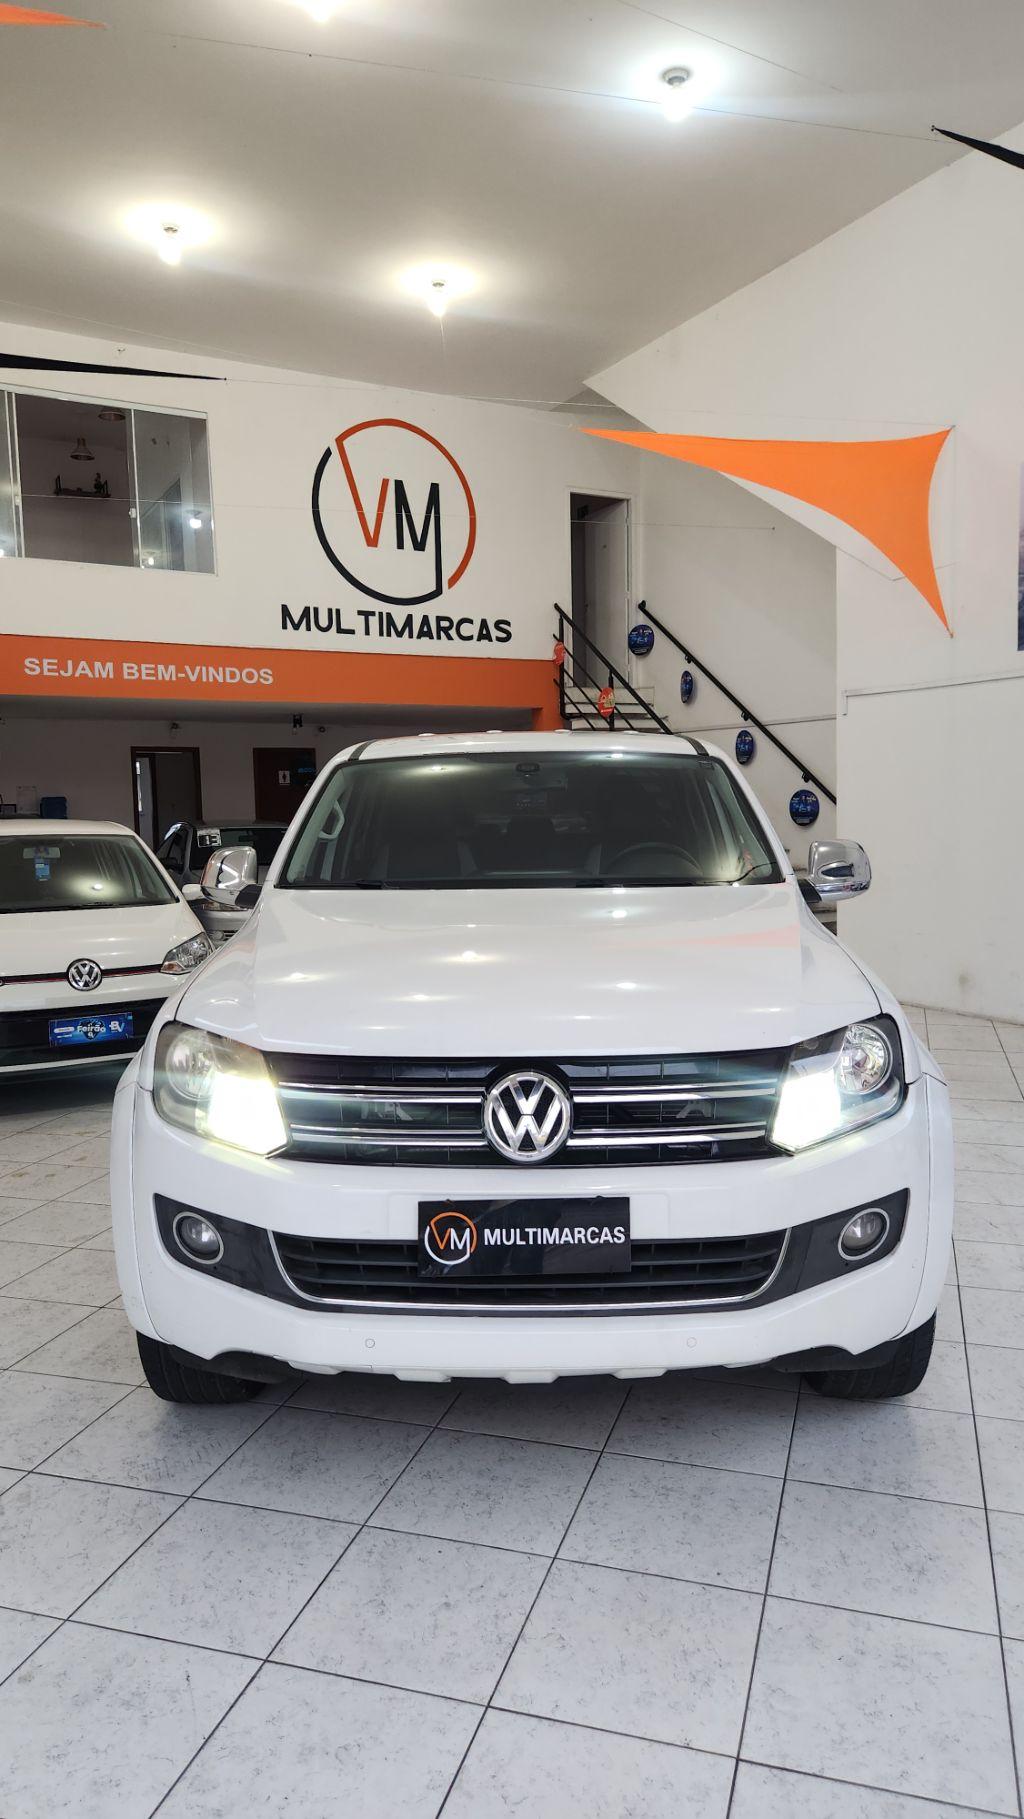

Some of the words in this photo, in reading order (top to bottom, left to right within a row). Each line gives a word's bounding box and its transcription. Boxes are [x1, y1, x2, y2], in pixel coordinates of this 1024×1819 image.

[281, 604, 513, 642] MULTIMARCAS
[24, 658, 114, 679] SEJAM
[122, 662, 274, 685] BEM-VINDOS
[484, 1226, 626, 1246] MULTIMARCAS
